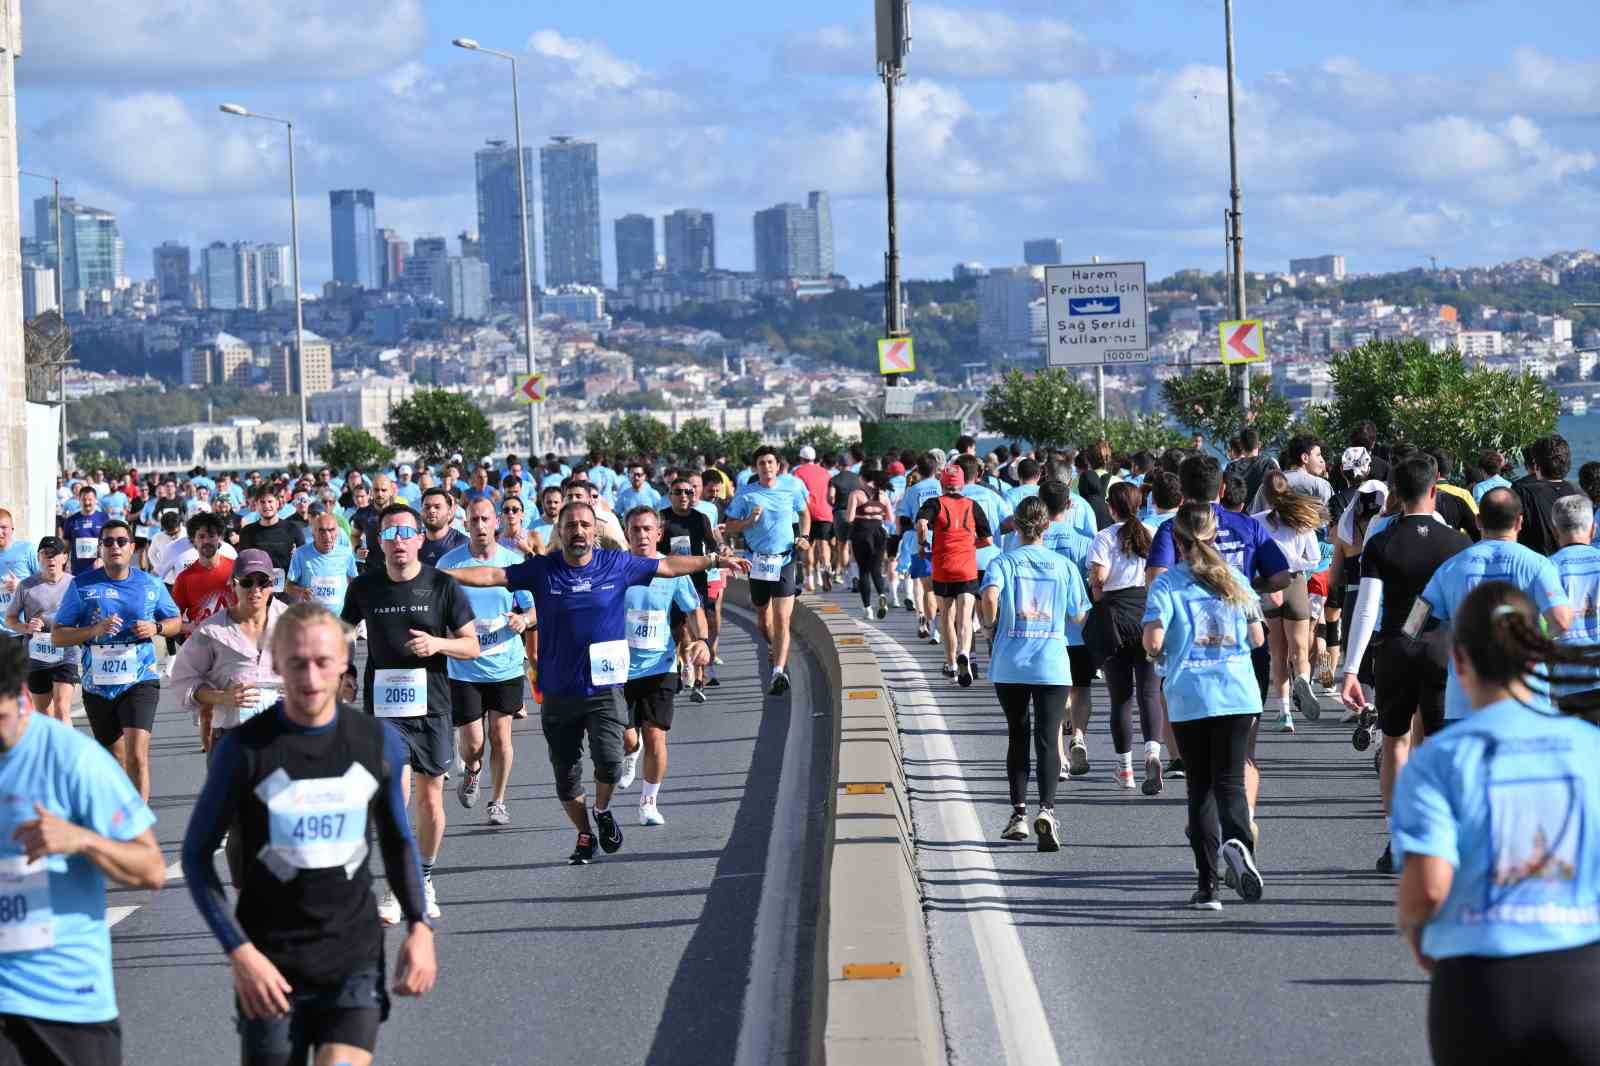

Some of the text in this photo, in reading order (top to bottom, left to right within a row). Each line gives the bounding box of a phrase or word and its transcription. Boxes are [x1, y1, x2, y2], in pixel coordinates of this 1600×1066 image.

[1072, 270, 1118, 280] Harem
[1051, 283, 1109, 295] Feribotu
[1057, 318, 1135, 332] Sağ Şeridi
[1107, 351, 1144, 360] 1000 m
[374, 606, 406, 614] FABRIC
[635, 624, 657, 638] 4871
[102, 660, 128, 673] 4274
[385, 688, 416, 703] 2059
[292, 813, 347, 841] 4967
[0, 894, 28, 923] 80
